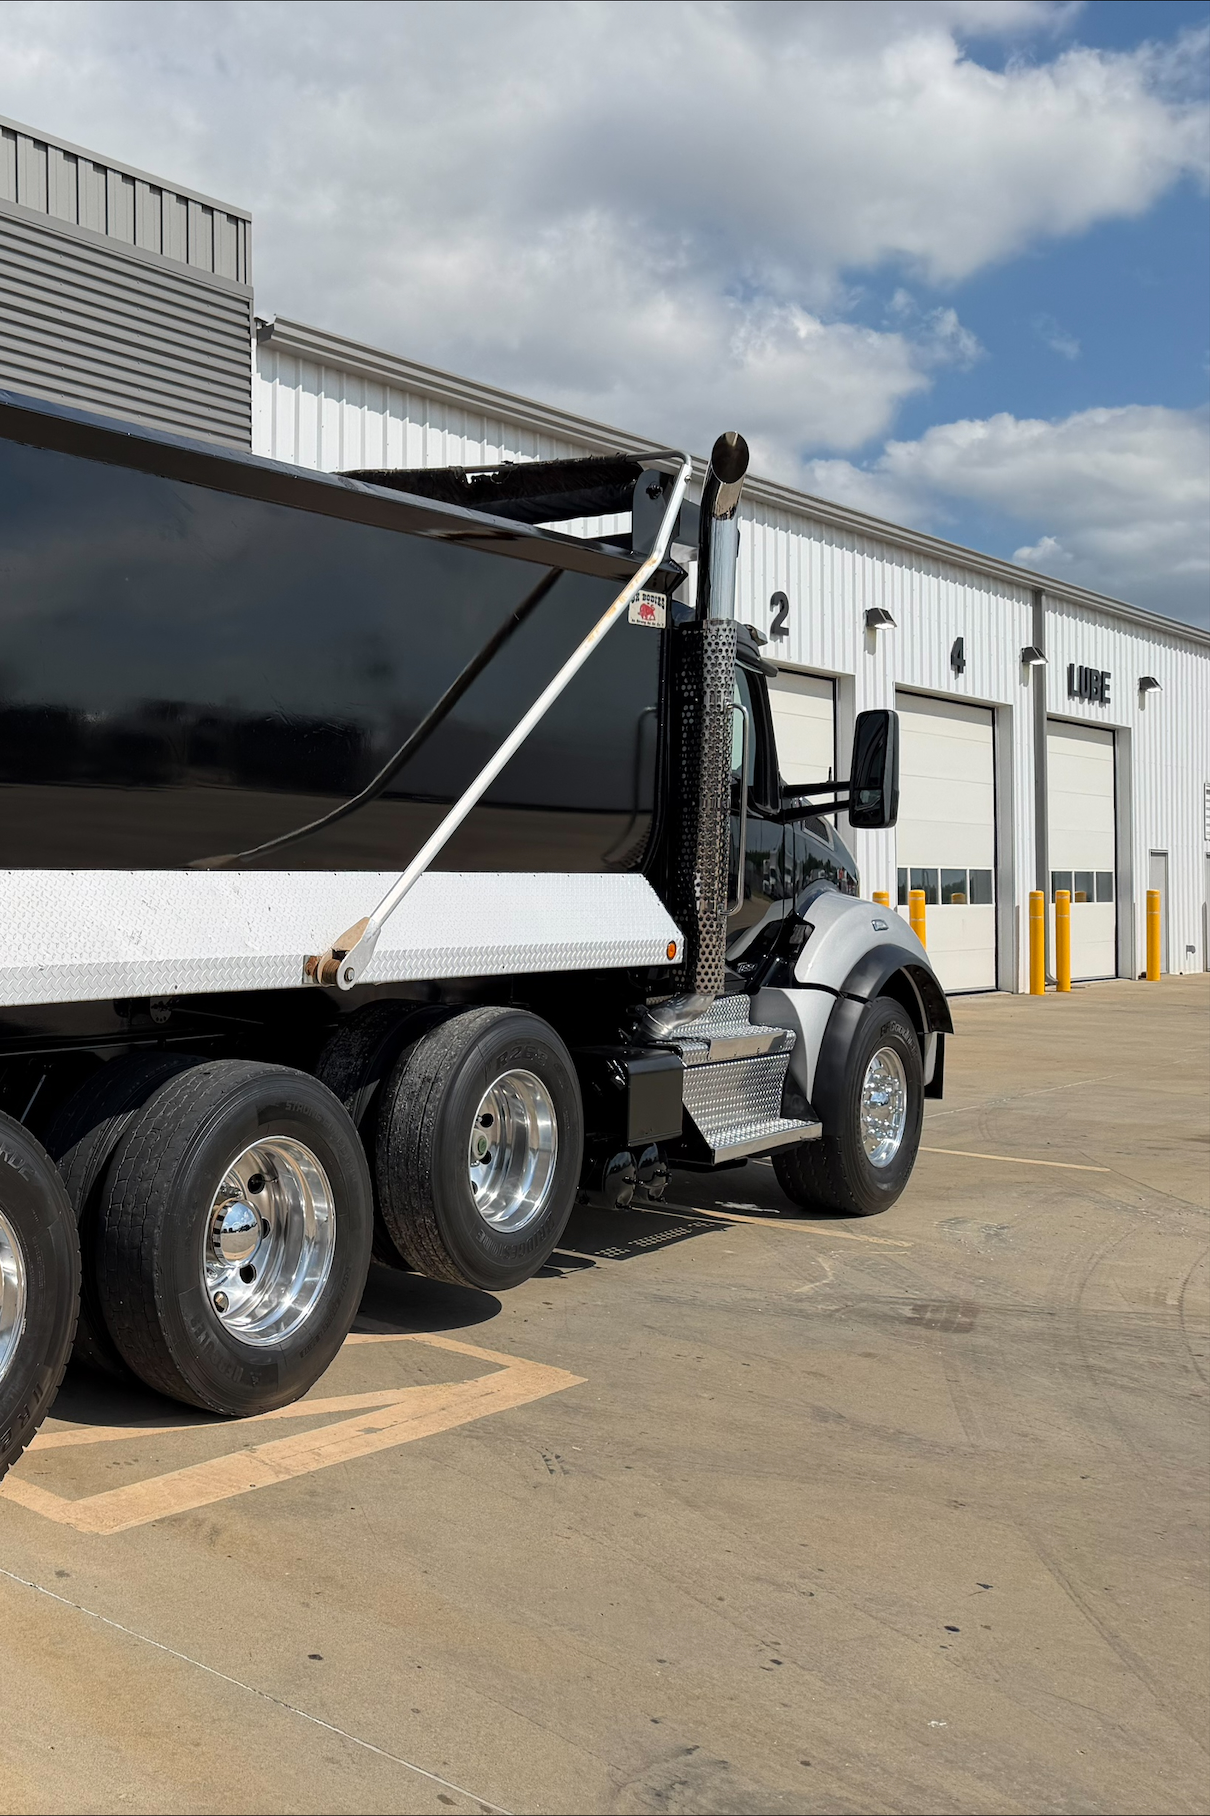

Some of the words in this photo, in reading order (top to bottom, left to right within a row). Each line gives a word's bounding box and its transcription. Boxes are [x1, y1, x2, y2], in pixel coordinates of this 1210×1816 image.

[642, 593, 665, 610] BODIES
[770, 591, 790, 636] 2
[950, 637, 966, 674] 4
[1067, 663, 1111, 704] LUBE
